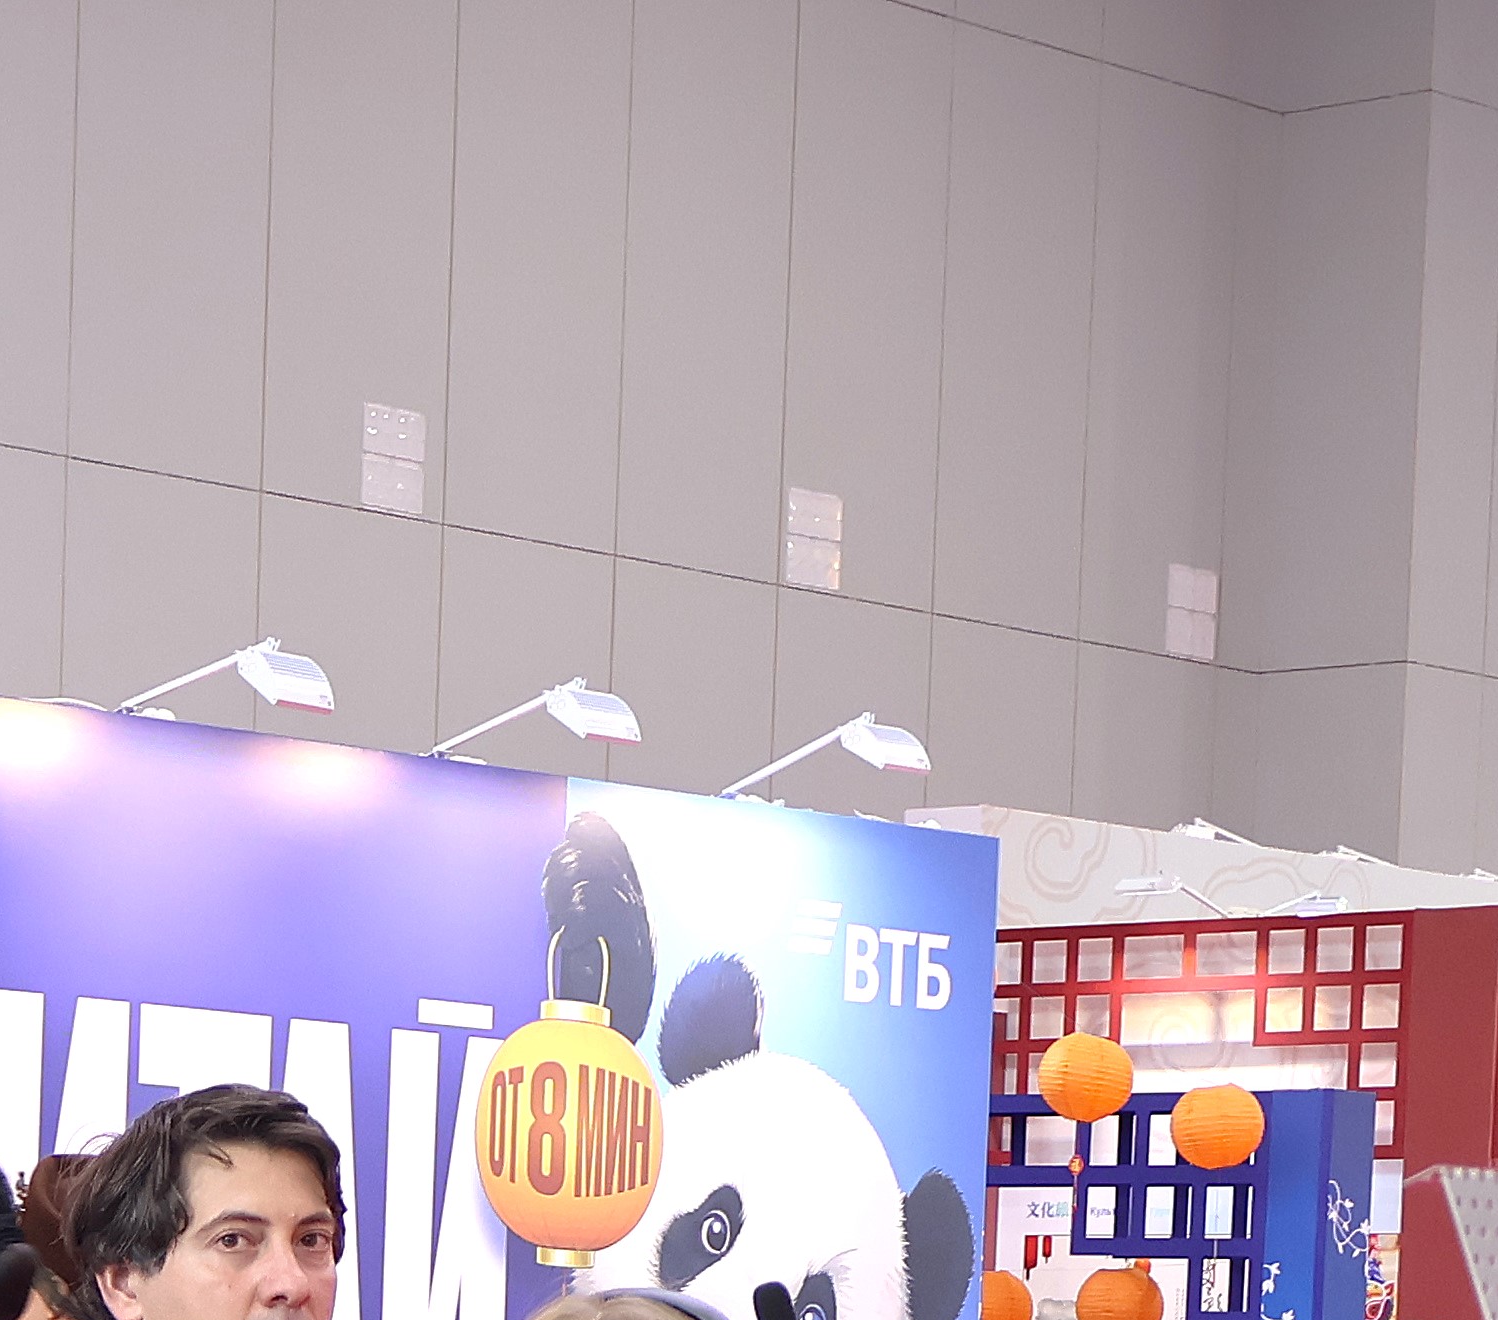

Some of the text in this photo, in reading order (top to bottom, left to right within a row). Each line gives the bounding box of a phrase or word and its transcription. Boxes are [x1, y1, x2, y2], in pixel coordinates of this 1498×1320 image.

[843, 923, 952, 1011] ВТБ
[489, 1061, 652, 1198] ОТ 8 МИН
